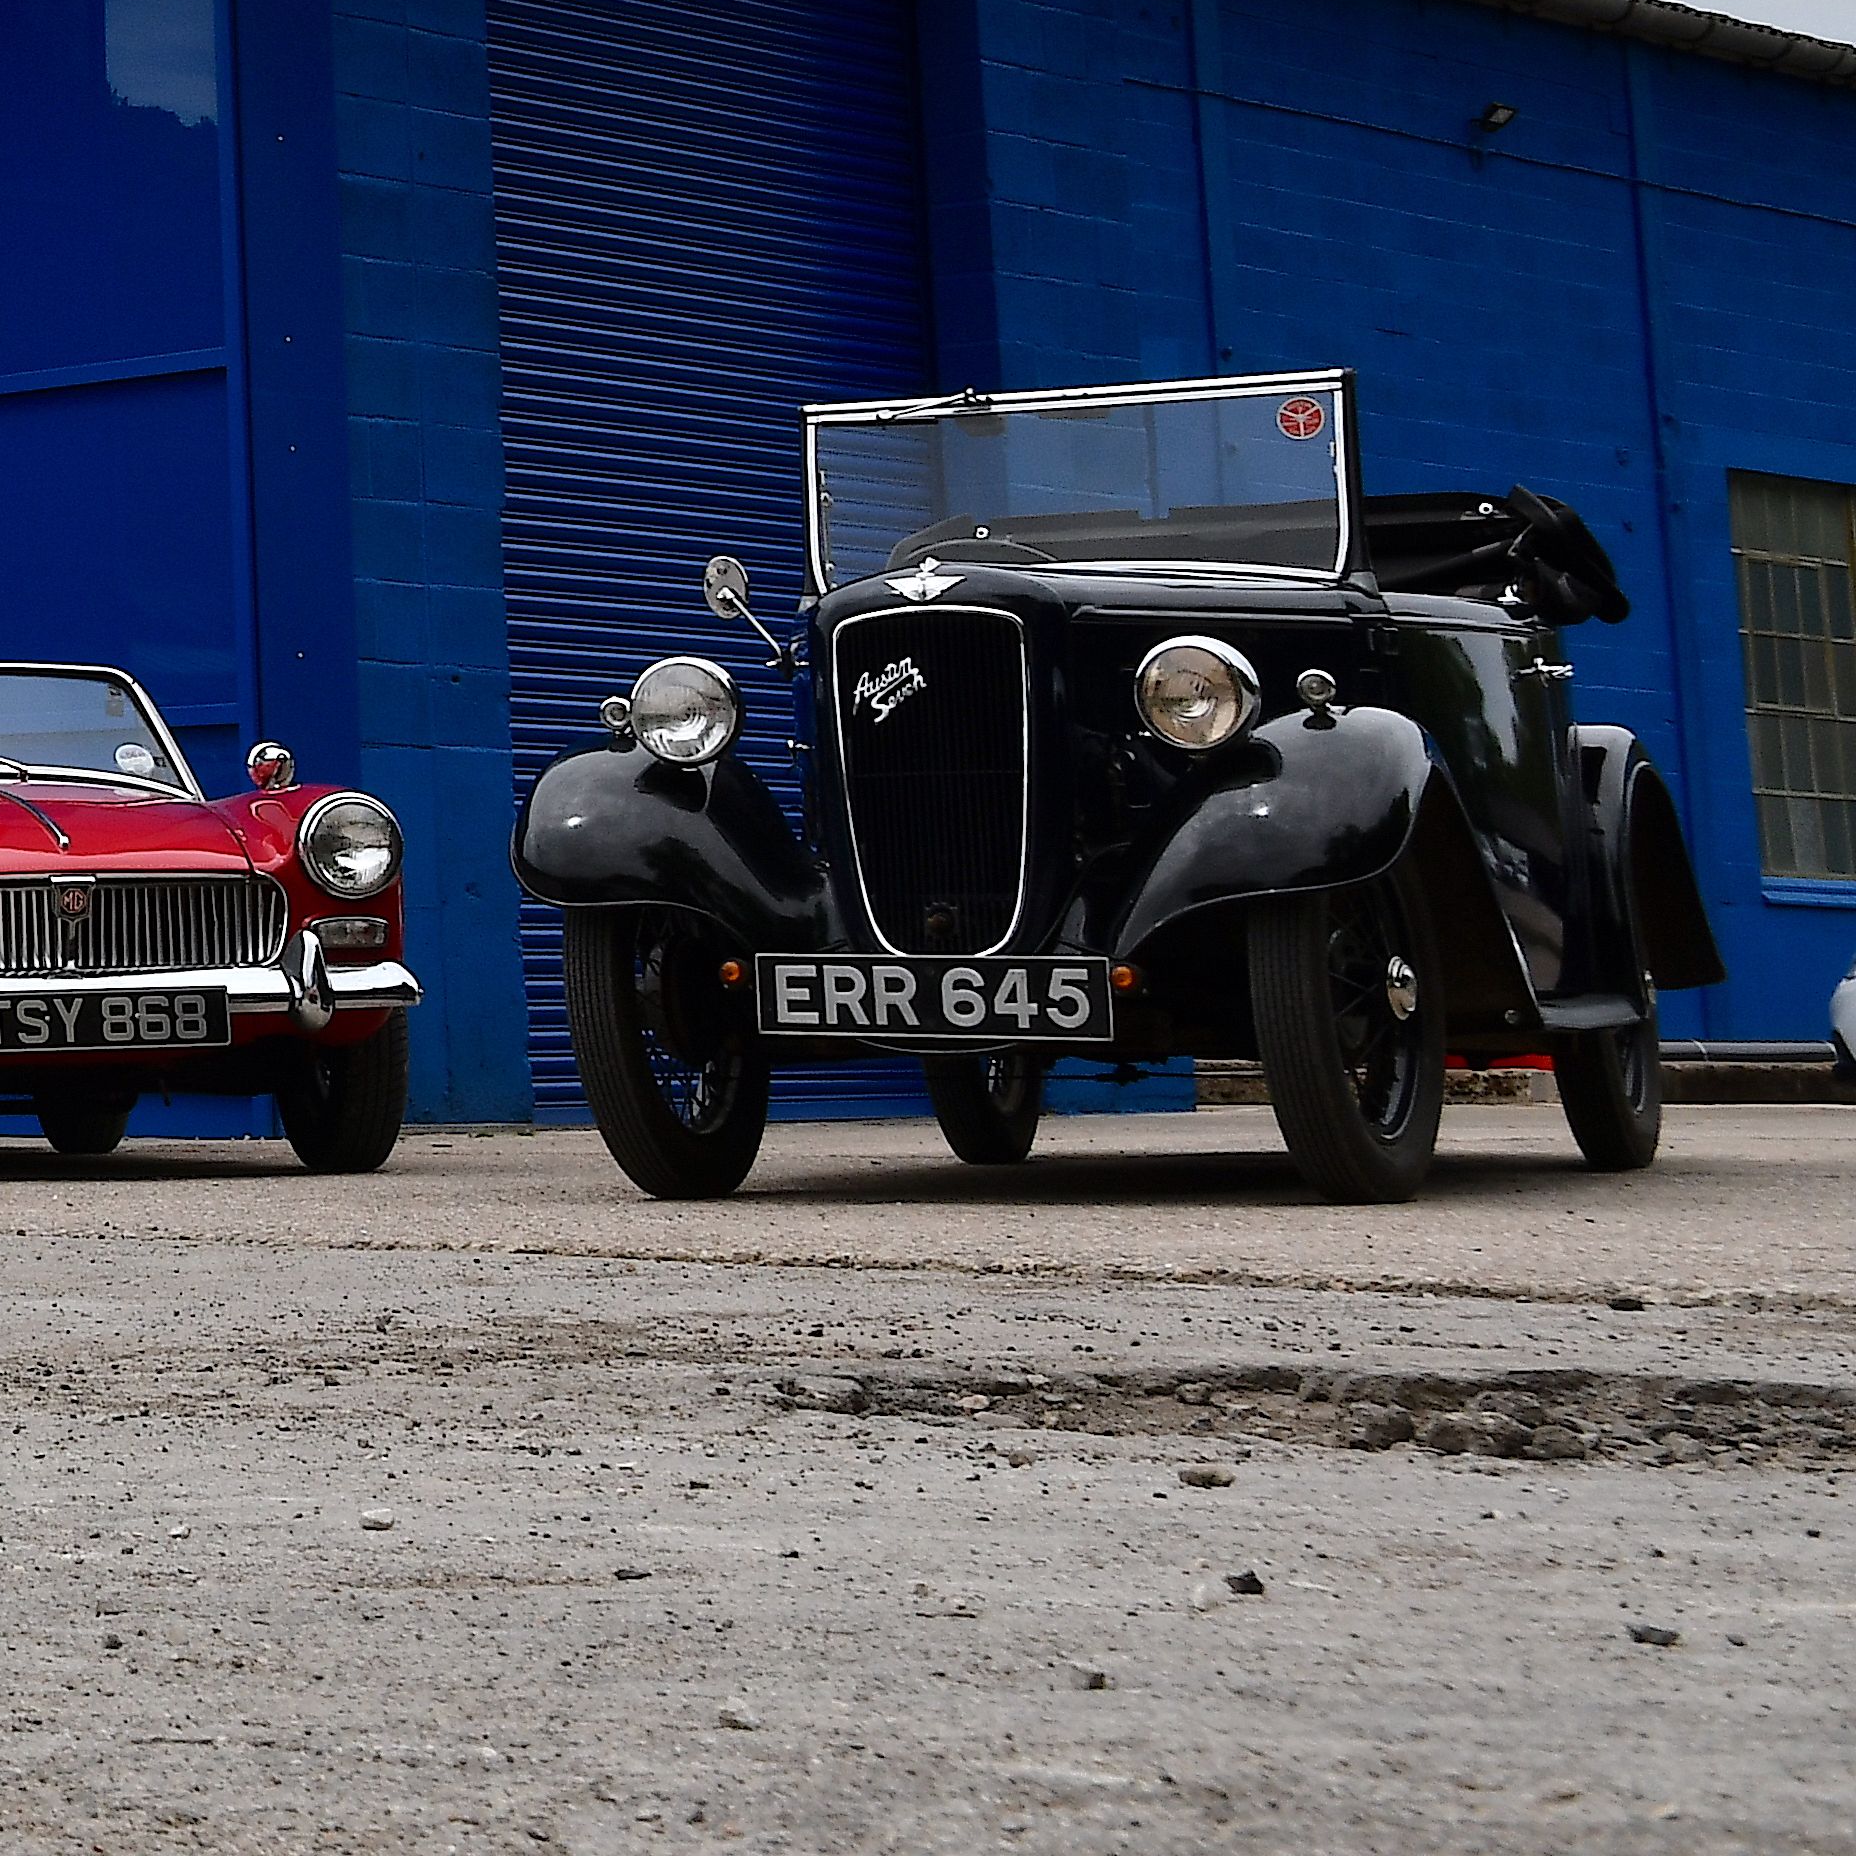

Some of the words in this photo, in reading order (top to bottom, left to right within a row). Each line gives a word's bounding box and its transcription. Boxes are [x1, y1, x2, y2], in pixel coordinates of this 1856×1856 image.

[853, 656, 919, 716] Austin
[871, 674, 928, 725] Seven
[63, 890, 84, 911] MG
[101, 994, 206, 1042] 868
[774, 964, 920, 1026] ERR
[941, 966, 1090, 1029] 645
